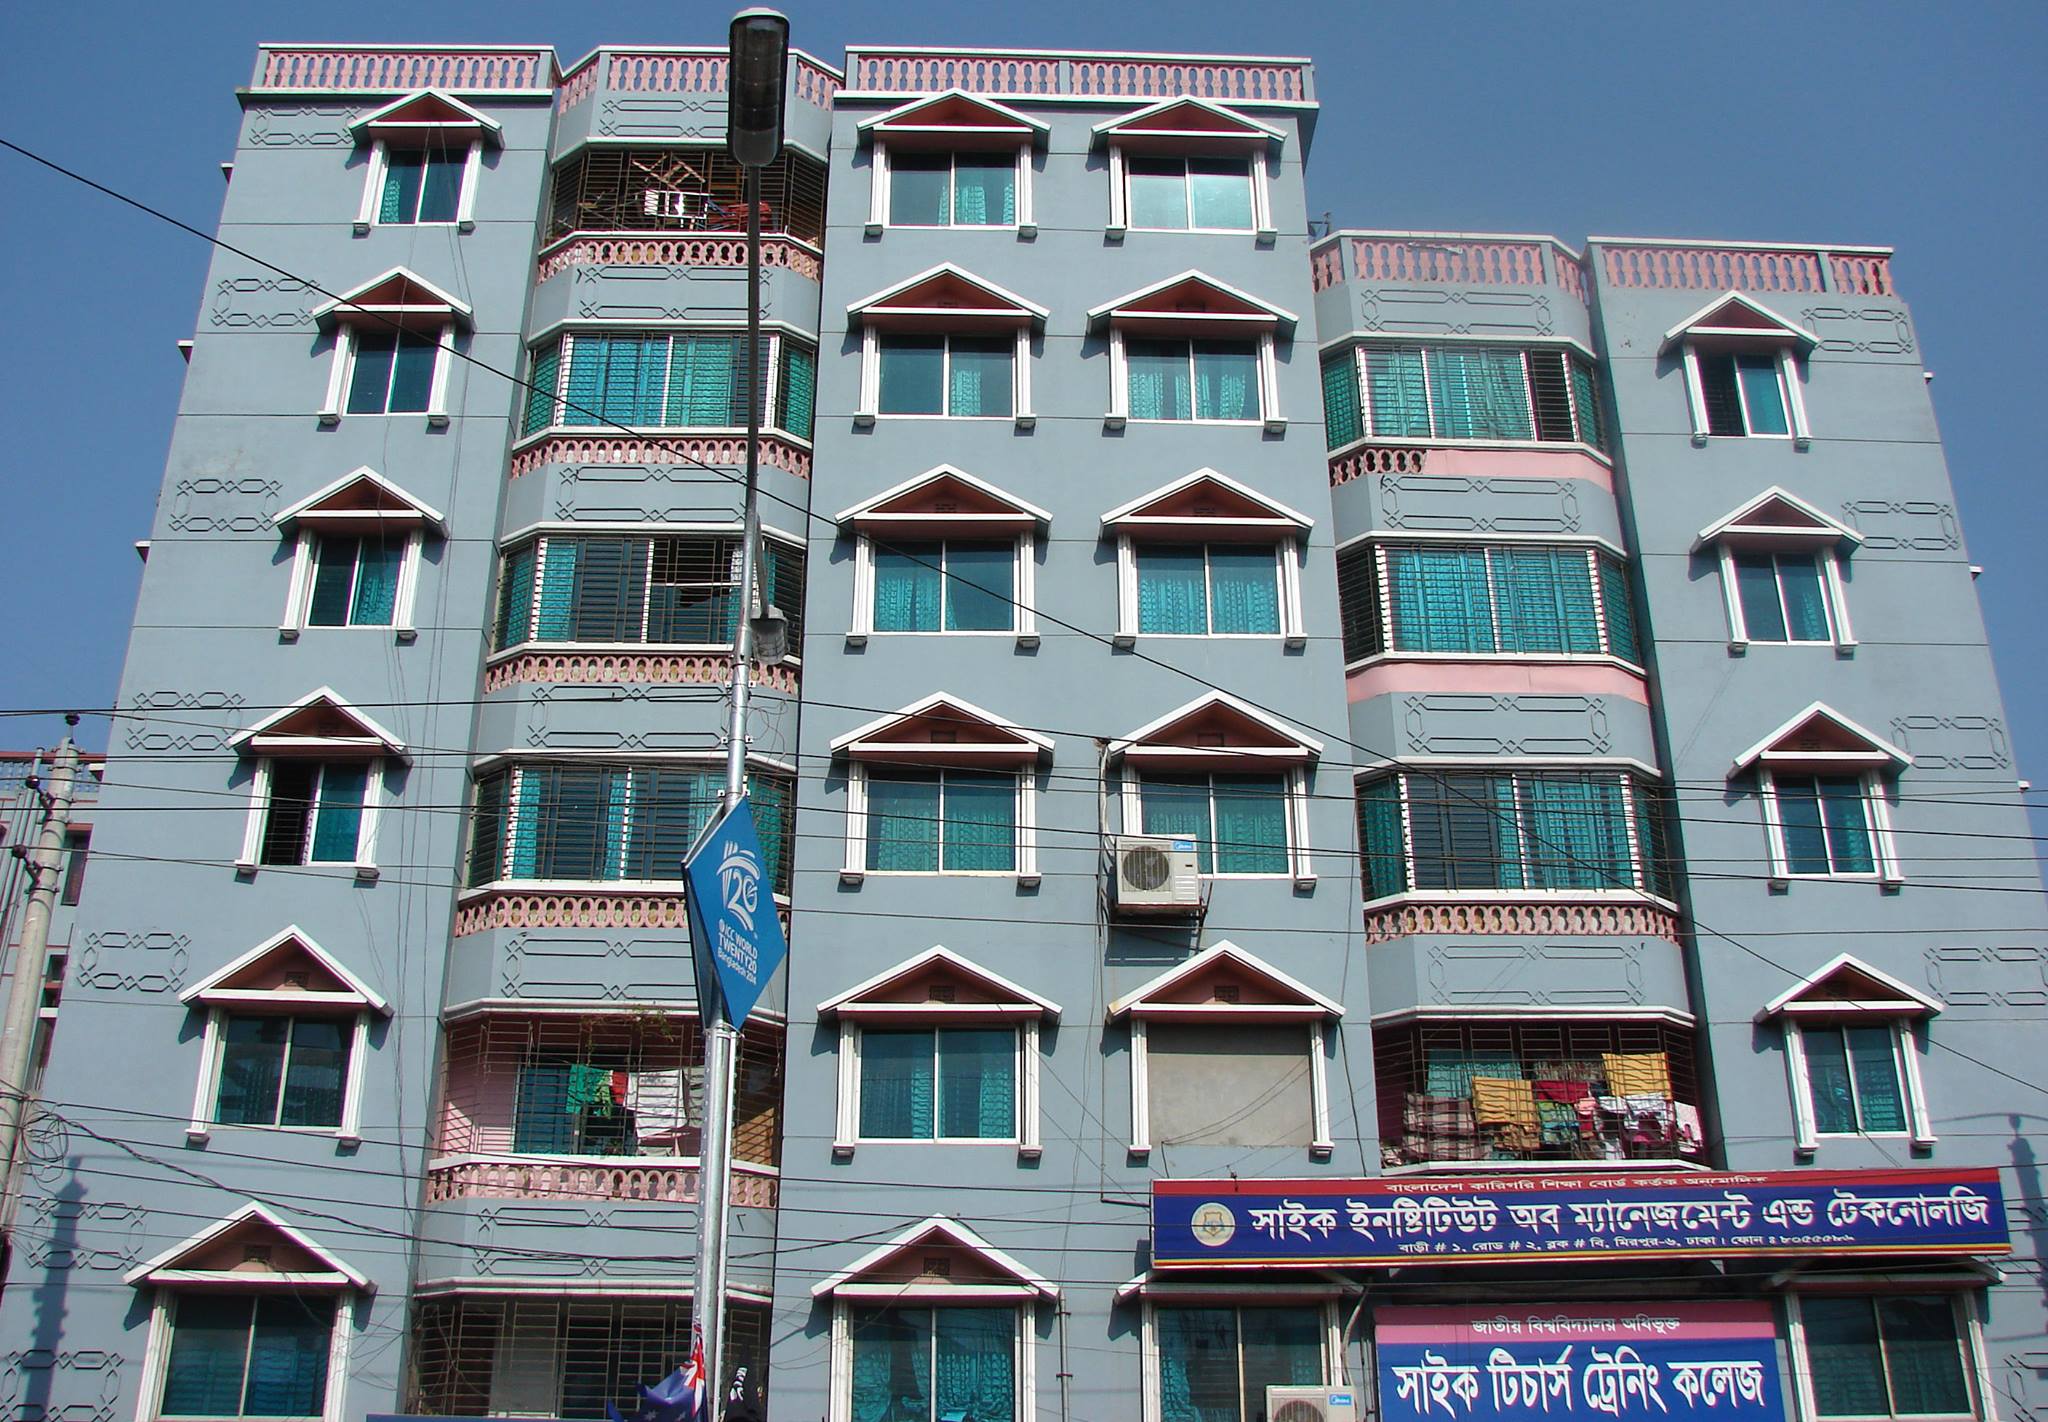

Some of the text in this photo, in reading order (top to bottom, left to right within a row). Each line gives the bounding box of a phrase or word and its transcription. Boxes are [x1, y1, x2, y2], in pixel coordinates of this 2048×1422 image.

[718, 932, 757, 974] TWENTY20
[735, 932, 758, 960] WORLD
[1385, 1182, 1463, 1192] বাংলাদেশ
[1470, 1180, 1535, 1191] কারিগরি
[1540, 1178, 1582, 1189] শিক্ষা
[1589, 1178, 1627, 1188] বোর্ড
[1247, 1198, 1338, 1242] সাইক
[1505, 1203, 1562, 1235] অব
[1567, 1190, 1753, 1233] ম্যানেজমেন্ট
[1762, 1199, 1815, 1229] এন্ড
[1826, 1185, 1990, 1227] টেকনোলজি
[1472, 1241, 1504, 1251] রোড
[1731, 1236, 1764, 1245] ফোন
[1471, 1315, 1522, 1334] জাতীয়
[1526, 1315, 1616, 1334] বিশ্ববিদ্যালয়
[1391, 1344, 1766, 1419] সাইক টিচার্স ট্রেনিং কলেজ
